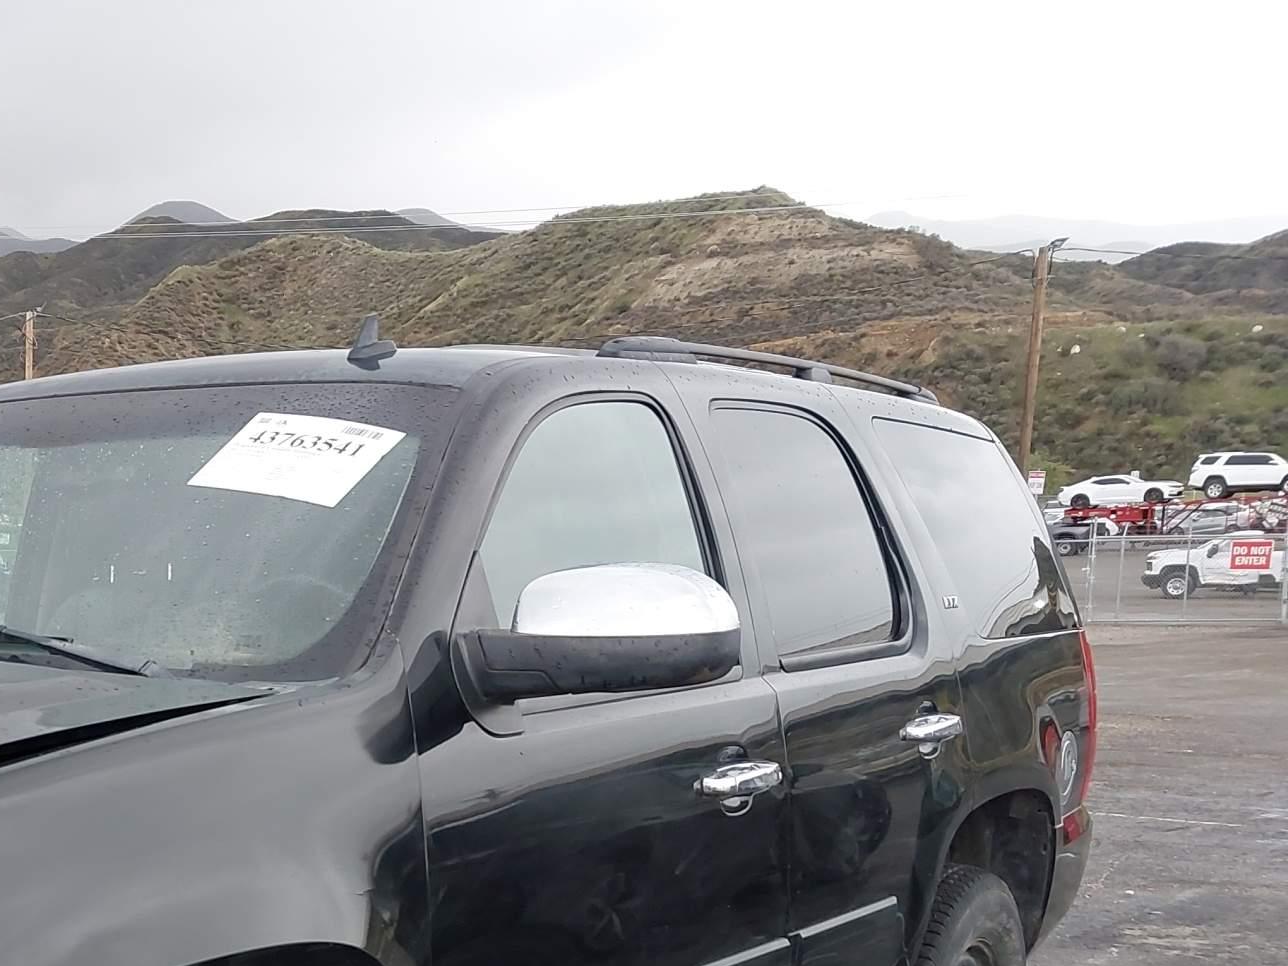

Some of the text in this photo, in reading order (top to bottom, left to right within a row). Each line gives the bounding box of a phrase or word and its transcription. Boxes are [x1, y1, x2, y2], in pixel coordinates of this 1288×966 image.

[248, 430, 366, 456] 43763541
[1233, 546, 1272, 555] DO NOT
[1234, 556, 1267, 566] ENTER
